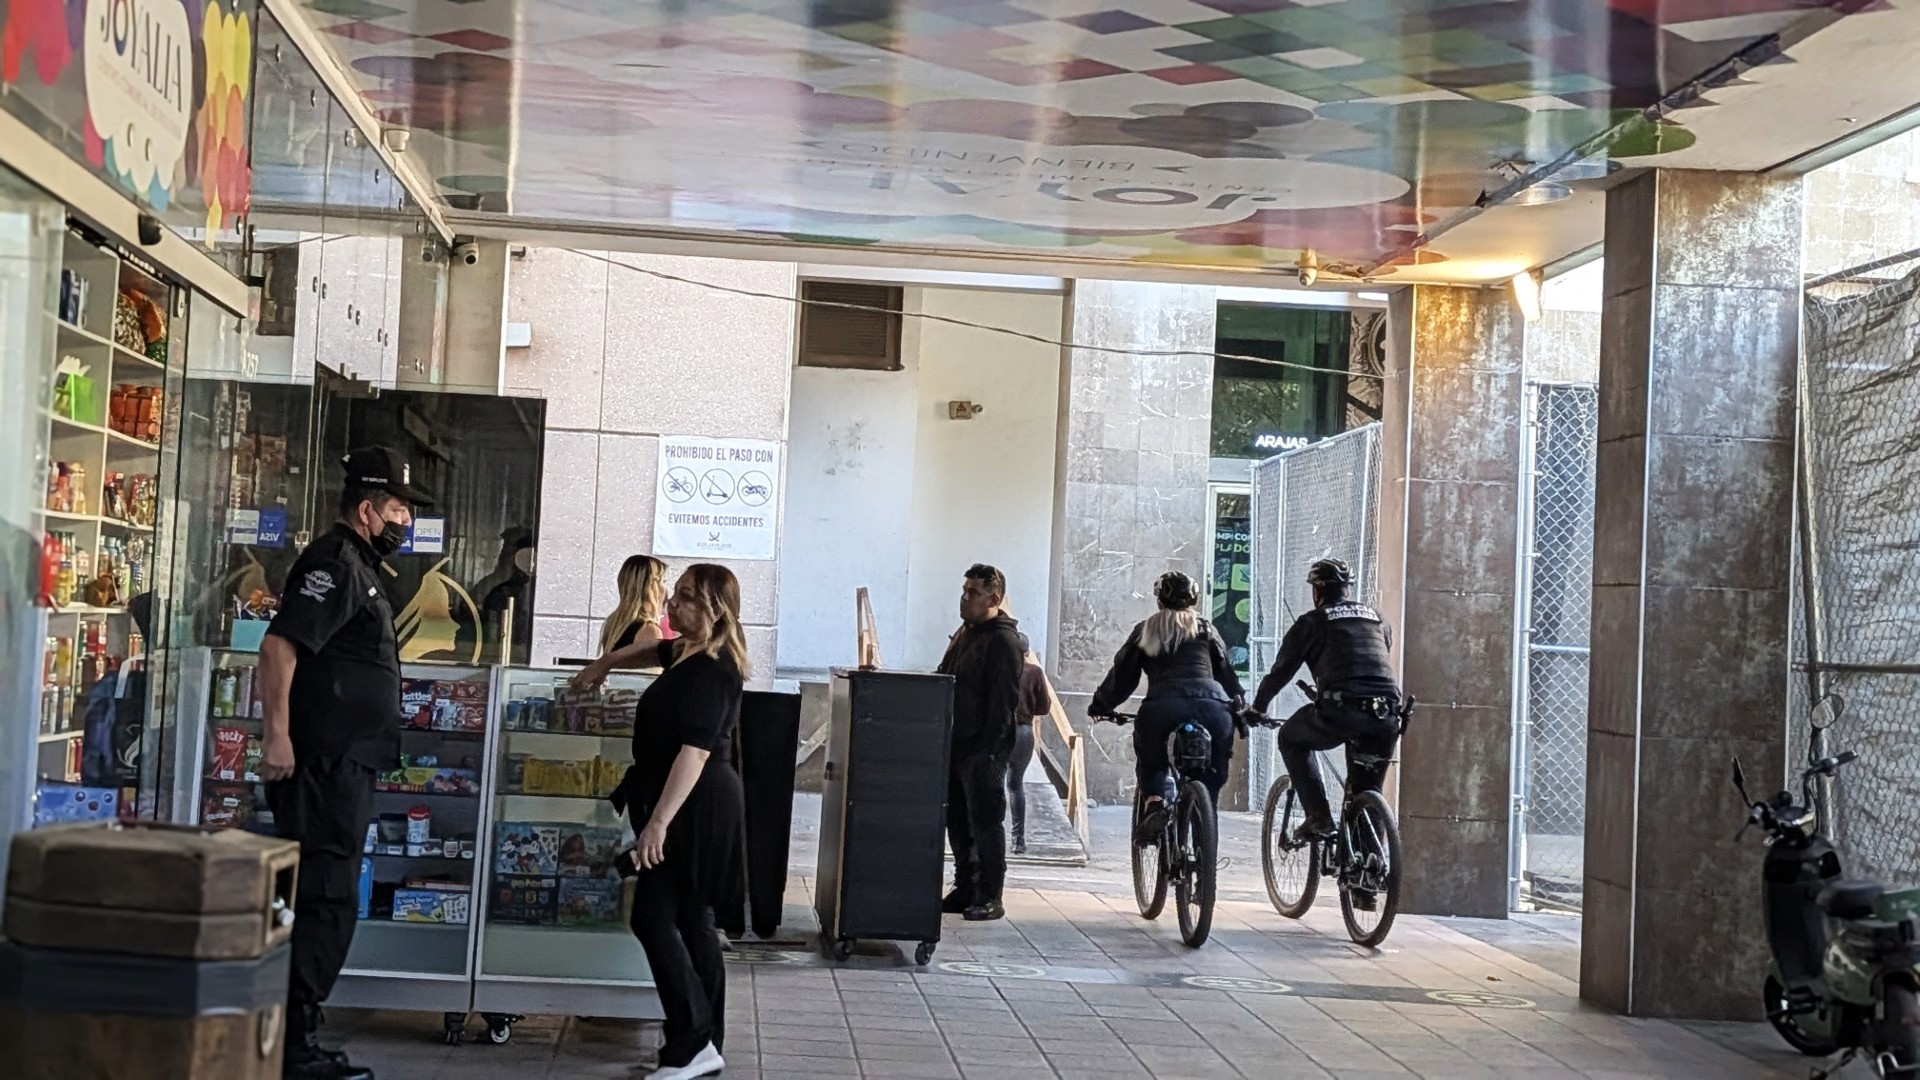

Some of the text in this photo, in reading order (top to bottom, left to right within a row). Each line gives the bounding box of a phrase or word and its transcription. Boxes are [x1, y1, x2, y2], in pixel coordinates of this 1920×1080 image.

[100, 0, 182, 113] JOYALIA
[665, 444, 773, 463] PROHIBIDO EL PASO CON
[668, 513, 764, 528] EVITEMOS ACCIDENTES
